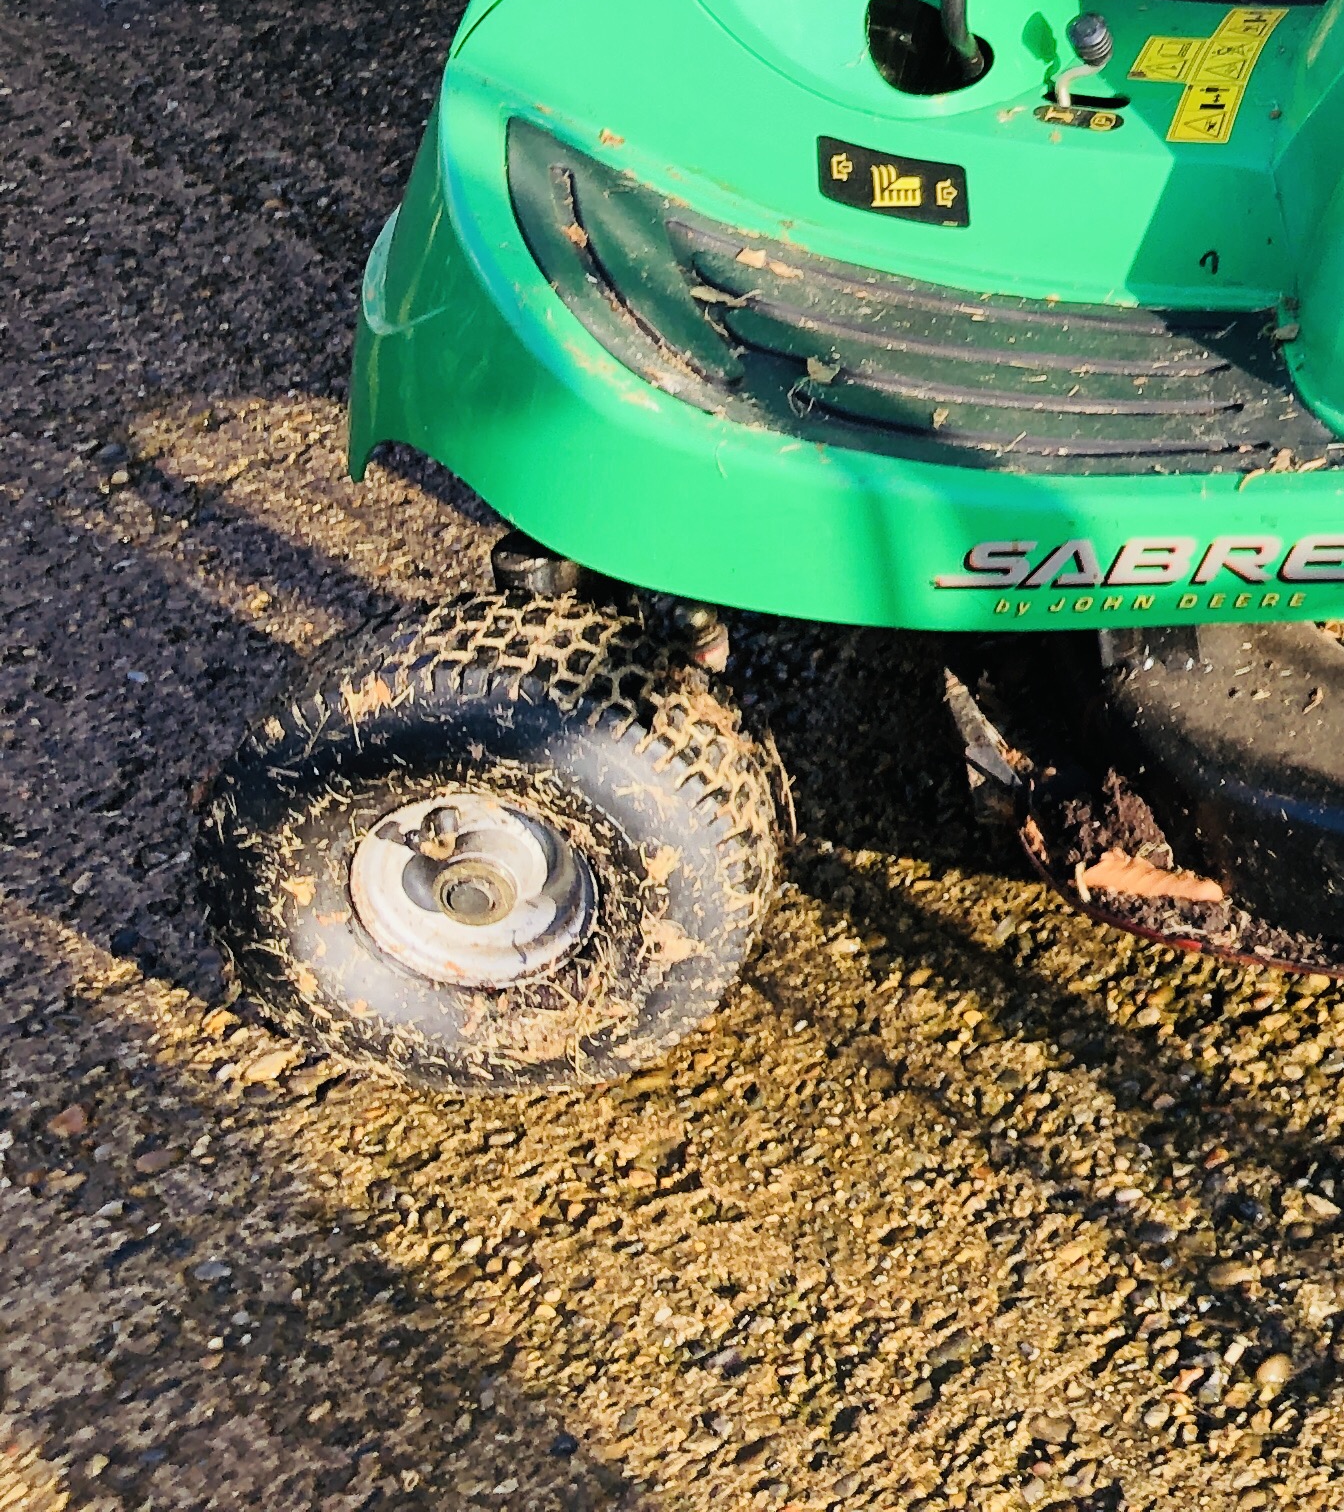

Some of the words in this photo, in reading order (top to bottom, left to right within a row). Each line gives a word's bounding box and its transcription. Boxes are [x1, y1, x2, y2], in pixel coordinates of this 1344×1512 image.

[995, 597, 1030, 617] by
[1049, 593, 1156, 614] JOHN
[1178, 591, 1308, 610] DEERE
